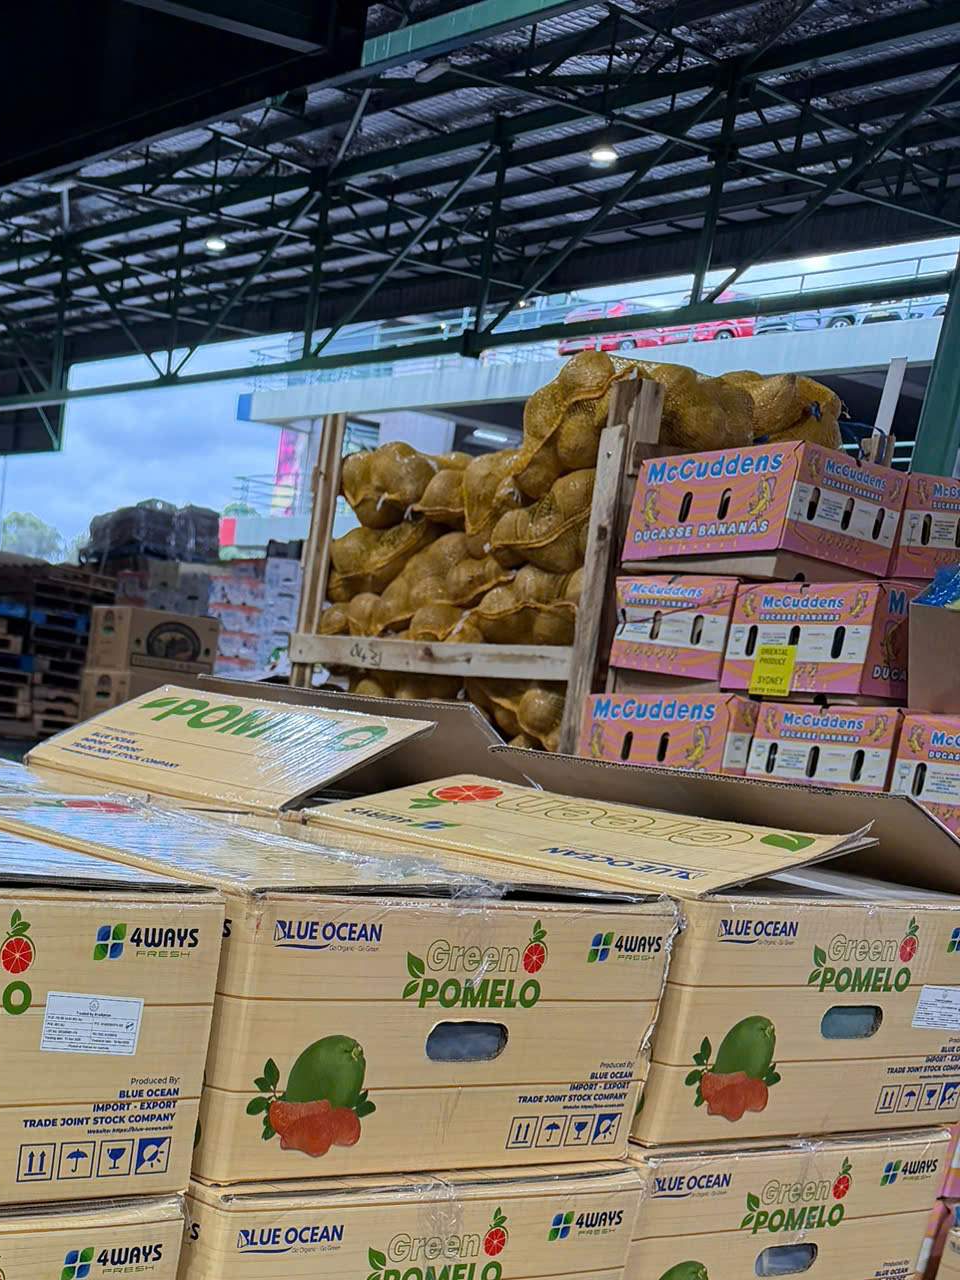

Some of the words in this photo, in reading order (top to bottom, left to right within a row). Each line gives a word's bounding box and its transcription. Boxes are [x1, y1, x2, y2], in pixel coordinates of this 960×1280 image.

[648, 453, 784, 484] McCuddens
[825, 459, 887, 492] McCuddens
[634, 526, 693, 542] DUCASSE
[698, 520, 769, 537] BANANAS
[630, 583, 704, 598] McCuddens
[762, 596, 844, 609] McCuddens
[592, 699, 716, 722] McCuddens
[783, 711, 864, 730] McCuddens
[130, 927, 199, 948] 4WAYS
[274, 919, 319, 942] BLUE
[321, 922, 383, 942] OCEAN
[719, 919, 751, 937] BLUE
[752, 919, 799, 937] OCEAN
[614, 935, 663, 953] 4WAYS
[827, 934, 897, 962] Green
[426, 939, 520, 972] Green
[819, 966, 911, 992] POMELO
[418, 978, 541, 1009] POMELO
[131, 1077, 167, 1085] Produced
[119, 1090, 144, 1099] BLUE
[146, 1088, 180, 1097] OCEAN
[594, 1092, 628, 1101] COMPANY
[93, 1103, 131, 1112] IMPORT
[140, 1100, 178, 1110] EXPORT
[23, 1118, 57, 1128] TRADE
[60, 1117, 90, 1127] JOINT
[93, 1115, 125, 1125] STOCK
[128, 1112, 176, 1123] COMPANY
[901, 1158, 938, 1177] 4WAYS
[654, 1176, 685, 1193] BLUE
[687, 1173, 732, 1190] OCEAN
[761, 1179, 832, 1206] Green
[576, 1209, 624, 1228] 4WAYS
[752, 1203, 845, 1235] POMELO
[238, 1228, 287, 1249] BLUE
[288, 1224, 344, 1245] OCEAN
[96, 1244, 163, 1265] 4WAYS
[387, 1232, 481, 1263] Green
